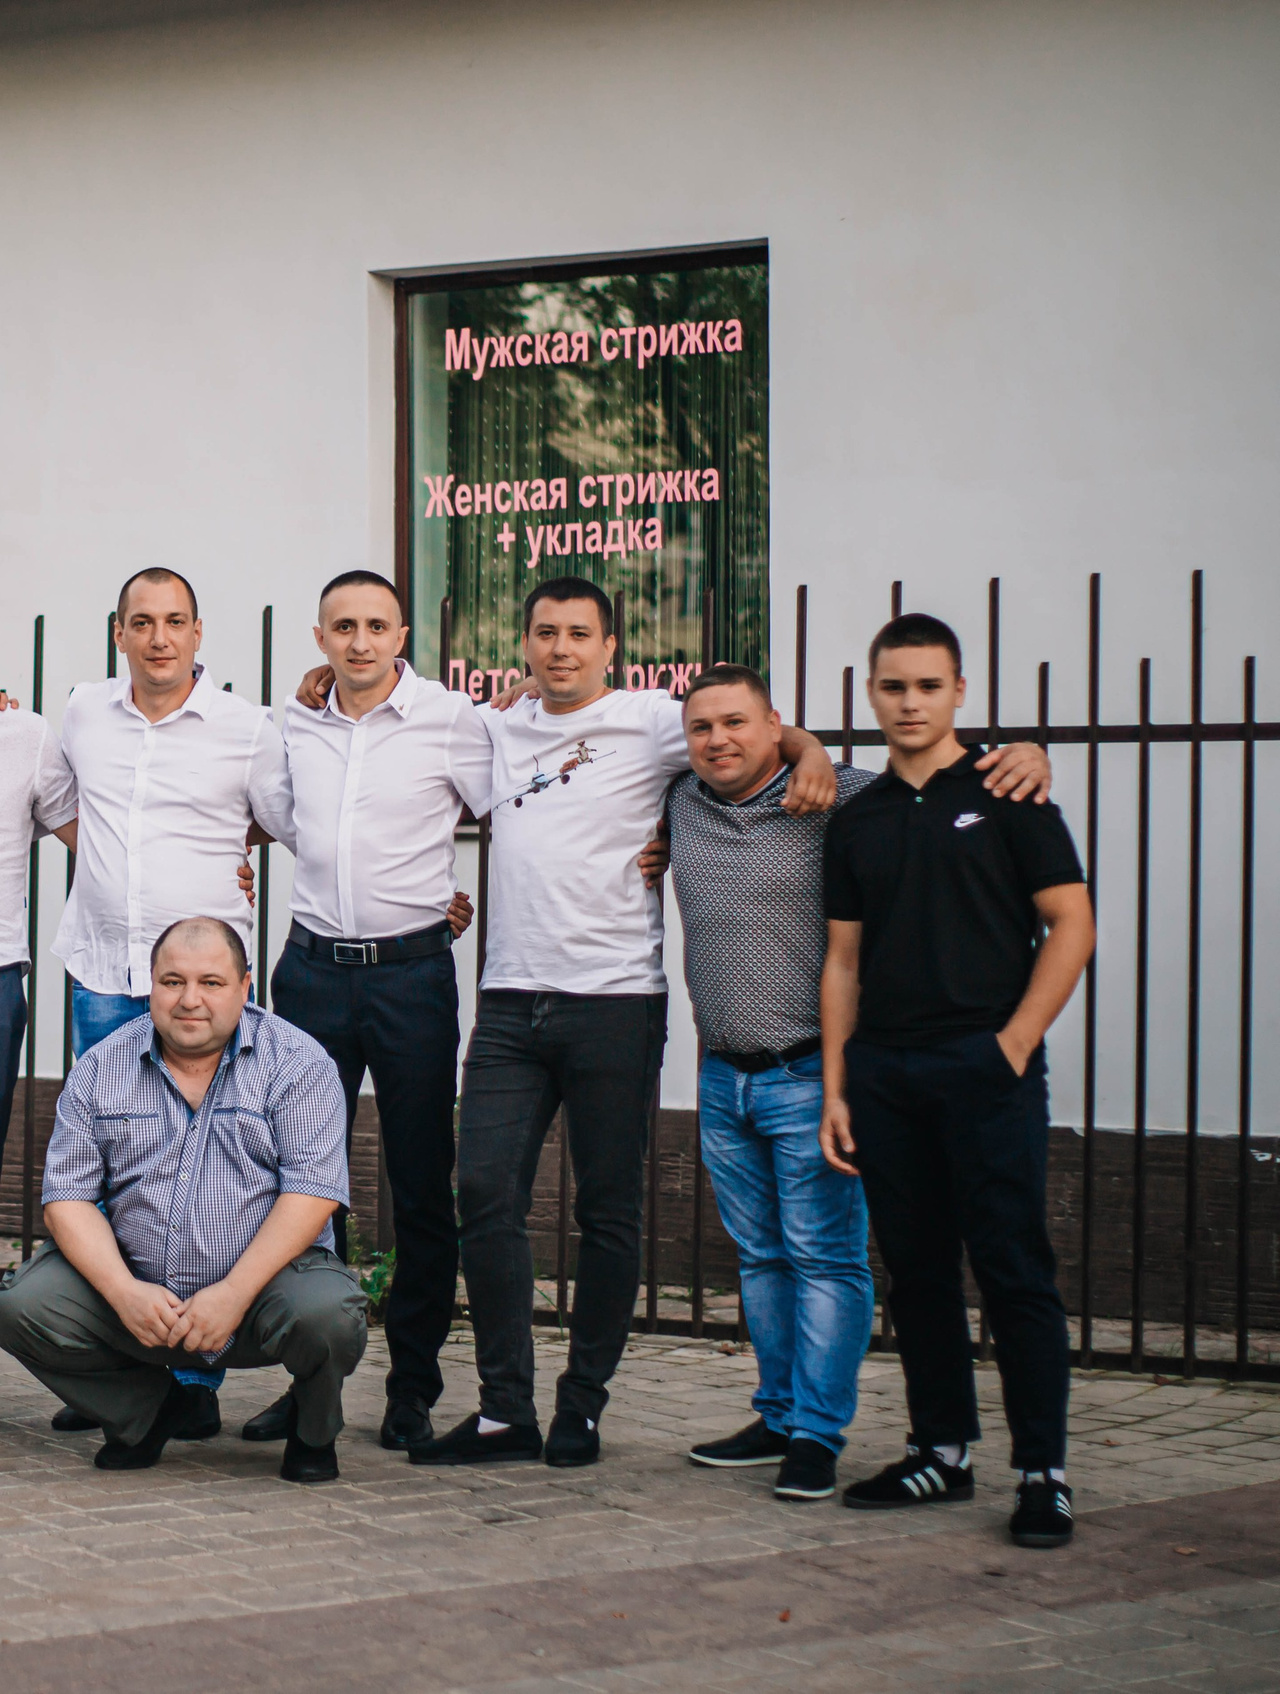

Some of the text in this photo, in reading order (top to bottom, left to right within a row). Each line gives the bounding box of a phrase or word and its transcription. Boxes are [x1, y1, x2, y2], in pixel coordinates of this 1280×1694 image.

[445, 318, 743, 381] Мужская стрижка
[423, 467, 720, 518] Женская стрижка
[496, 517, 663, 569] + укладка
[449, 659, 526, 702] Детс
